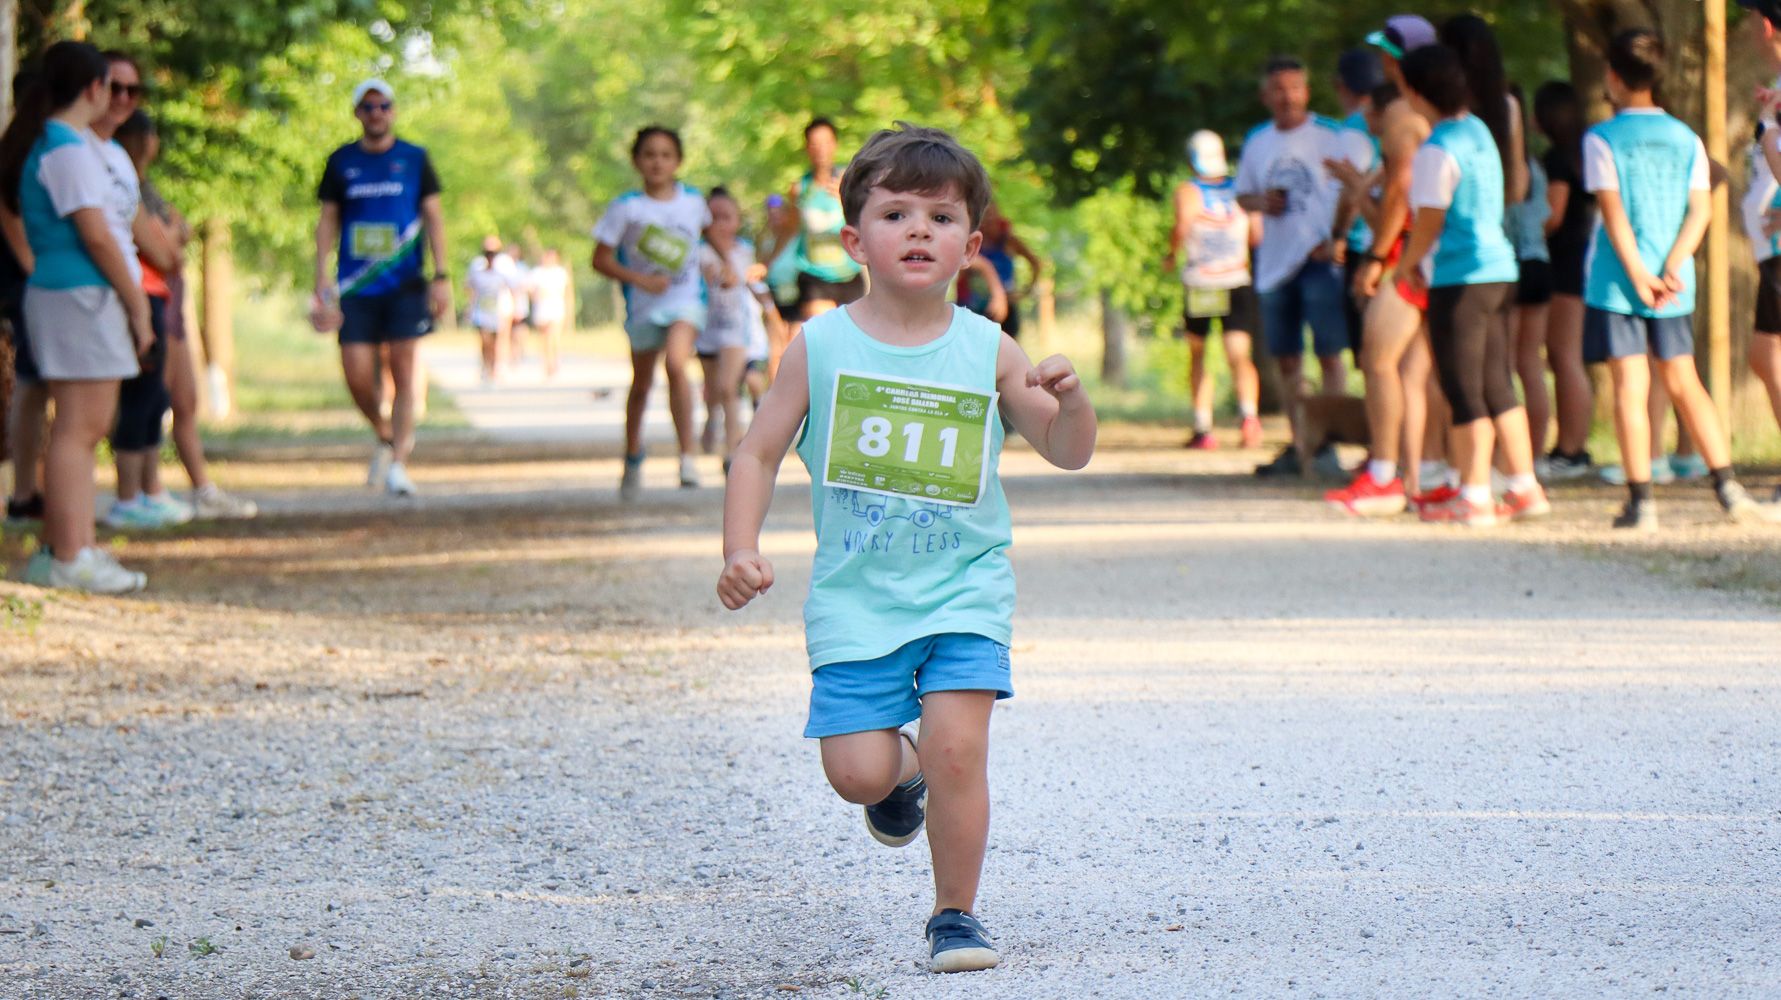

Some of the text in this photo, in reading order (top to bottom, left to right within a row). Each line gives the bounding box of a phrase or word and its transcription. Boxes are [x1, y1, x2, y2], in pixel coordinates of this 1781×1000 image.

[920, 391, 957, 403] MEMORIAL
[857, 416, 959, 468] 811
[913, 531, 961, 553] LESS
